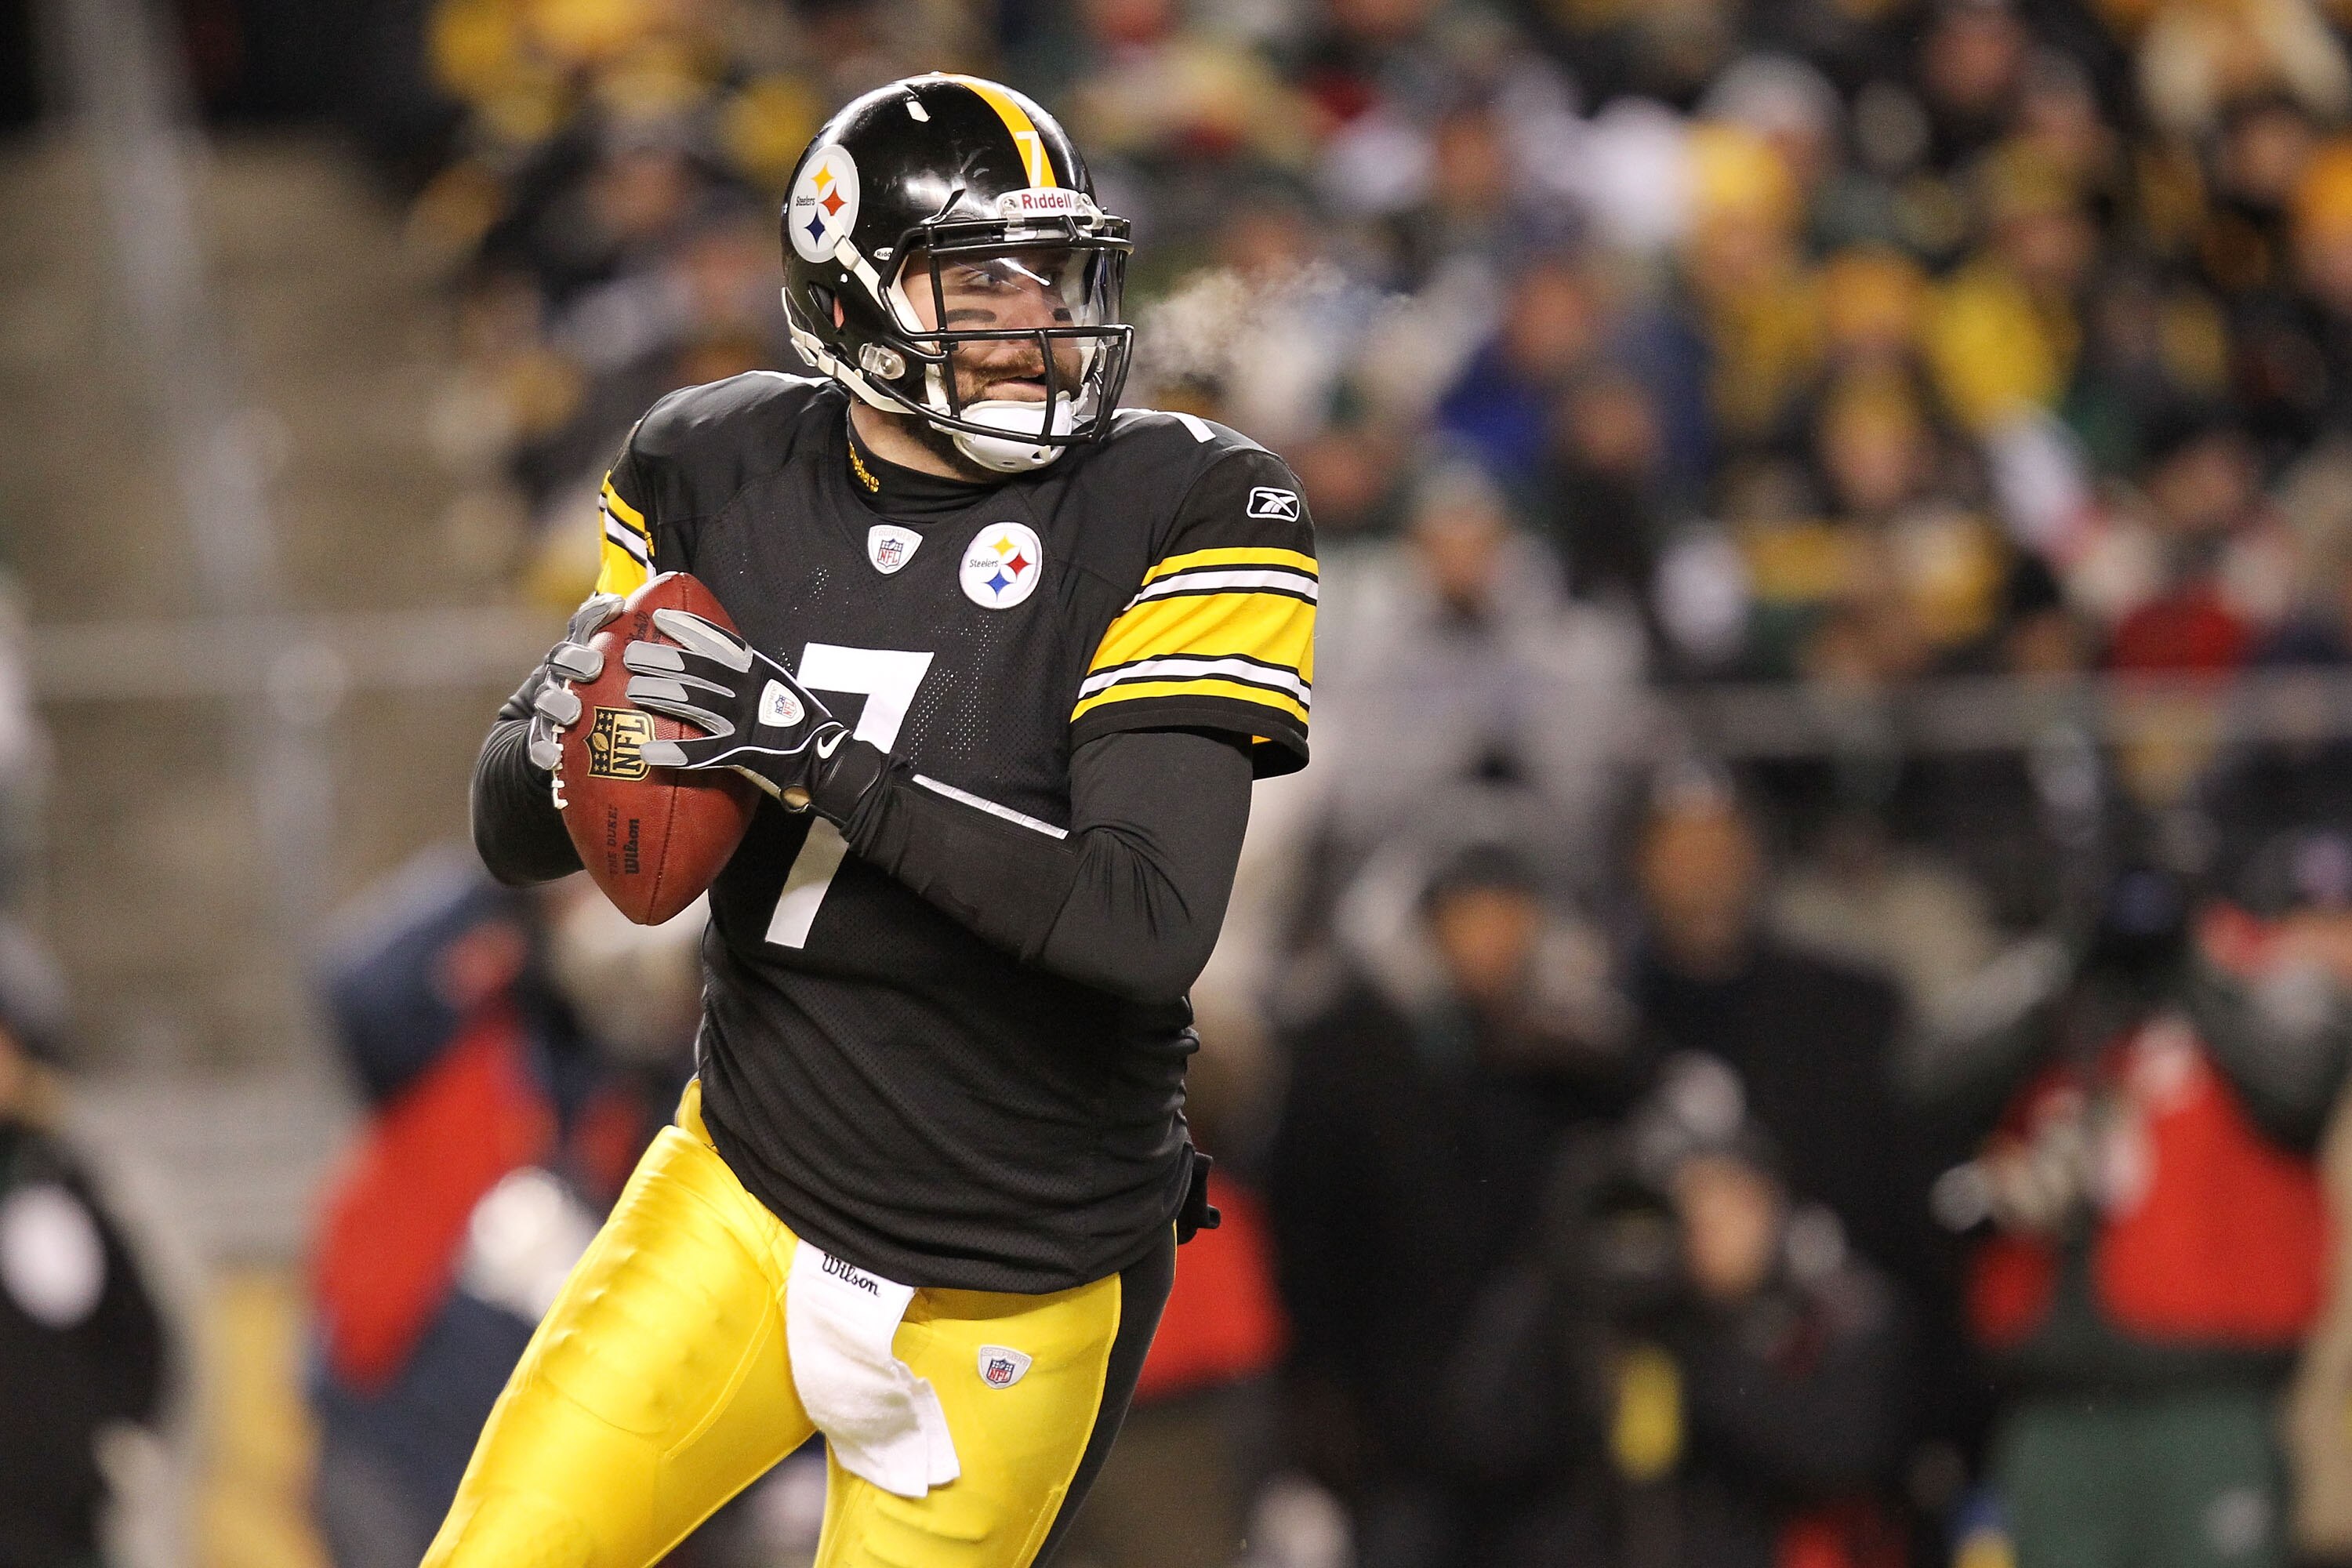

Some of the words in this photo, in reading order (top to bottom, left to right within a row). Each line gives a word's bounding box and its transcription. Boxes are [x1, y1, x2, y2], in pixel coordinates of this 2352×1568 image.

[1015, 130, 1041, 188] 7
[1022, 193, 1073, 209] Riddell
[880, 550, 898, 564] NFL
[969, 558, 999, 568] Steelers
[783, 702, 796, 717] NFL
[612, 719, 646, 771] NFL
[765, 641, 935, 949] 7
[623, 818, 640, 875] Wilson
[822, 1253, 880, 1297] Wilson
[989, 1369, 1008, 1381] NFL
